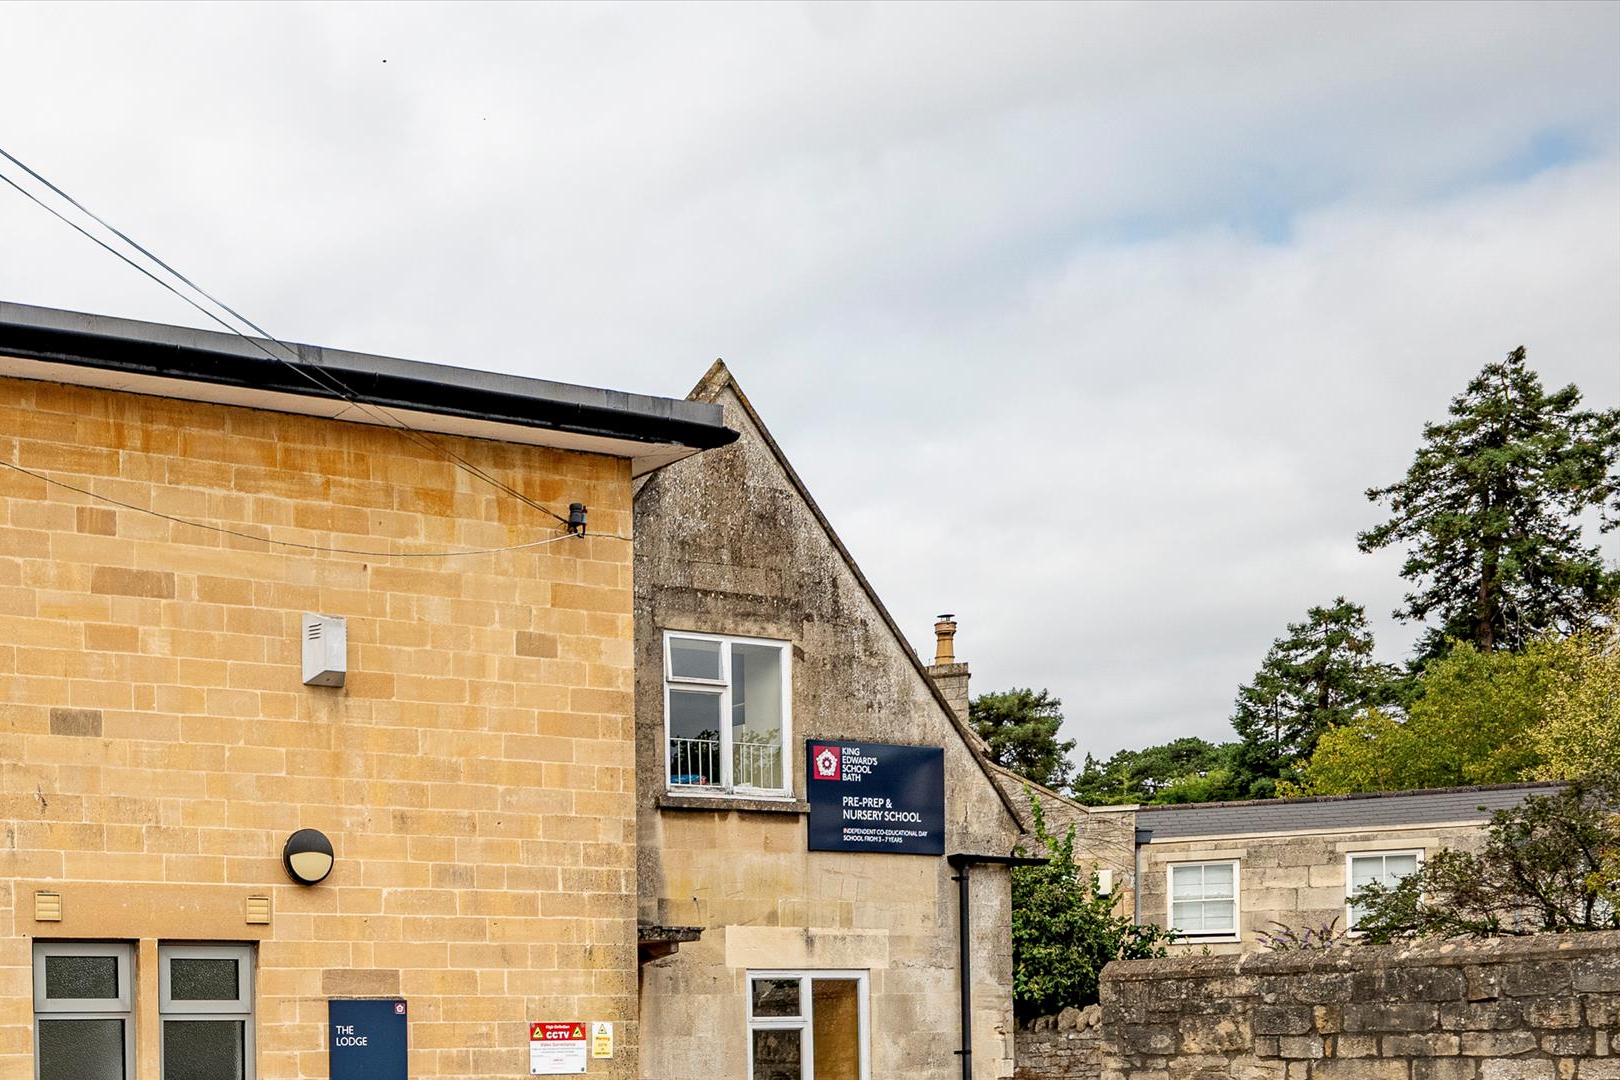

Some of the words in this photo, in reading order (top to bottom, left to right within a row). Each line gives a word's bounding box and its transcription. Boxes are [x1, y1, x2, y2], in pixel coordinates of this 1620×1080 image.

[842, 747, 860, 756] KING
[842, 755, 878, 766] EDWARD'S
[842, 764, 872, 774] SCHOOL
[842, 773, 861, 782] BATH
[842, 796, 884, 808] PRE-PREP
[885, 798, 893, 809] &
[843, 809, 883, 820] NURSERY
[884, 811, 922, 823] SCHOOL
[335, 1025, 354, 1035] THE
[546, 1031, 570, 1039] CCTV
[335, 1036, 368, 1047] LODGE
